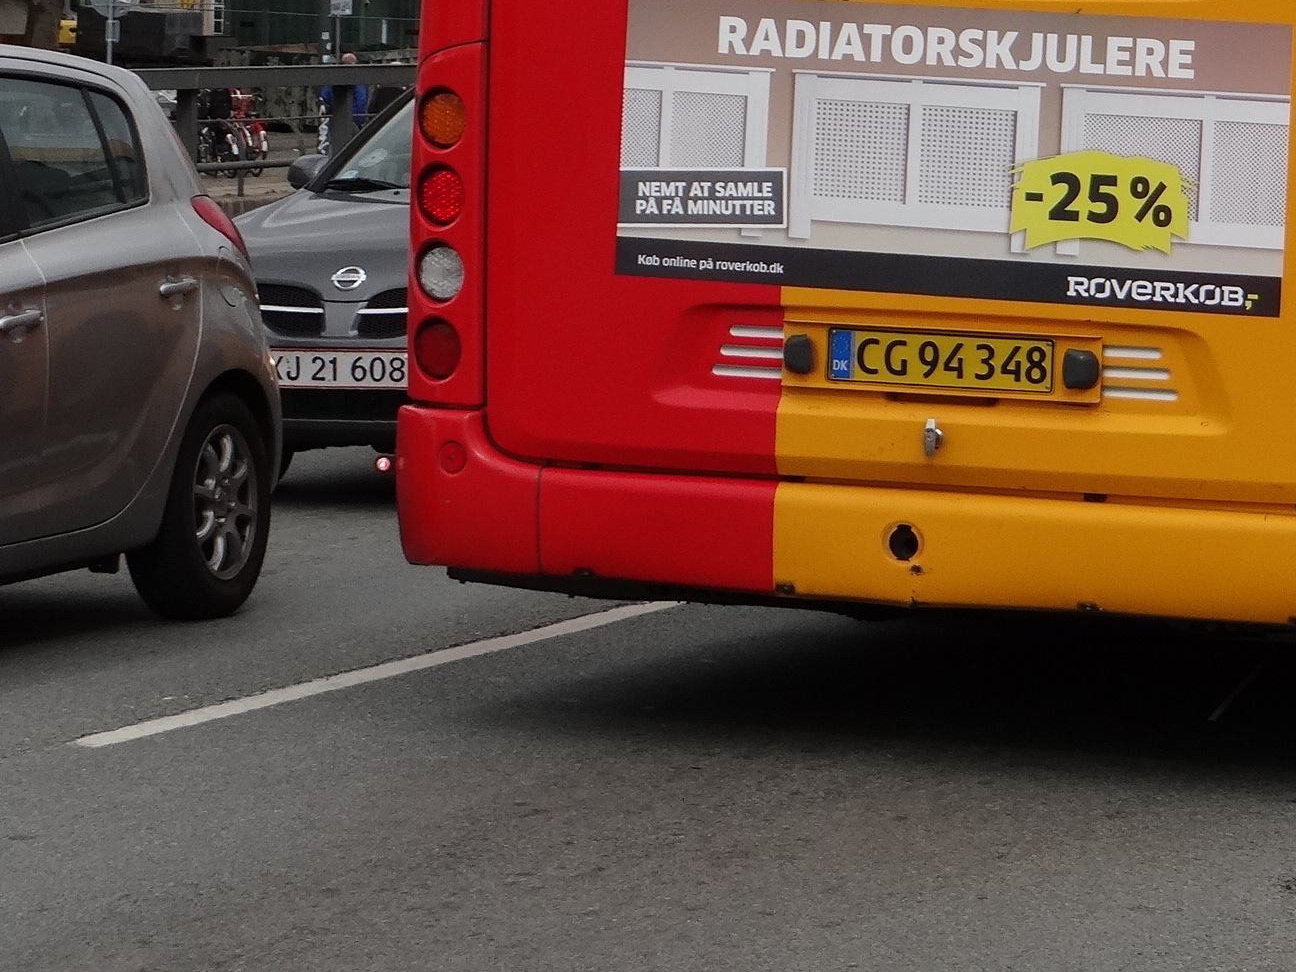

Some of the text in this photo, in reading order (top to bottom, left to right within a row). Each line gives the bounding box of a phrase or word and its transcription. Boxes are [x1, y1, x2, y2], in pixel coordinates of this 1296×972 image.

[717, 15, 1196, 80] RADIATORSKJULERE
[637, 181, 773, 198] NEMT AT SAMLE
[1025, 171, 1173, 228] -25%
[635, 197, 775, 215] PÅ FÅ MINUTTER
[637, 254, 784, 274] Køb online på roverkob.dk
[311, 356, 338, 382] 21
[351, 356, 405, 382] 608
[832, 359, 848, 371] DK
[857, 337, 1047, 385] CG 94 348
